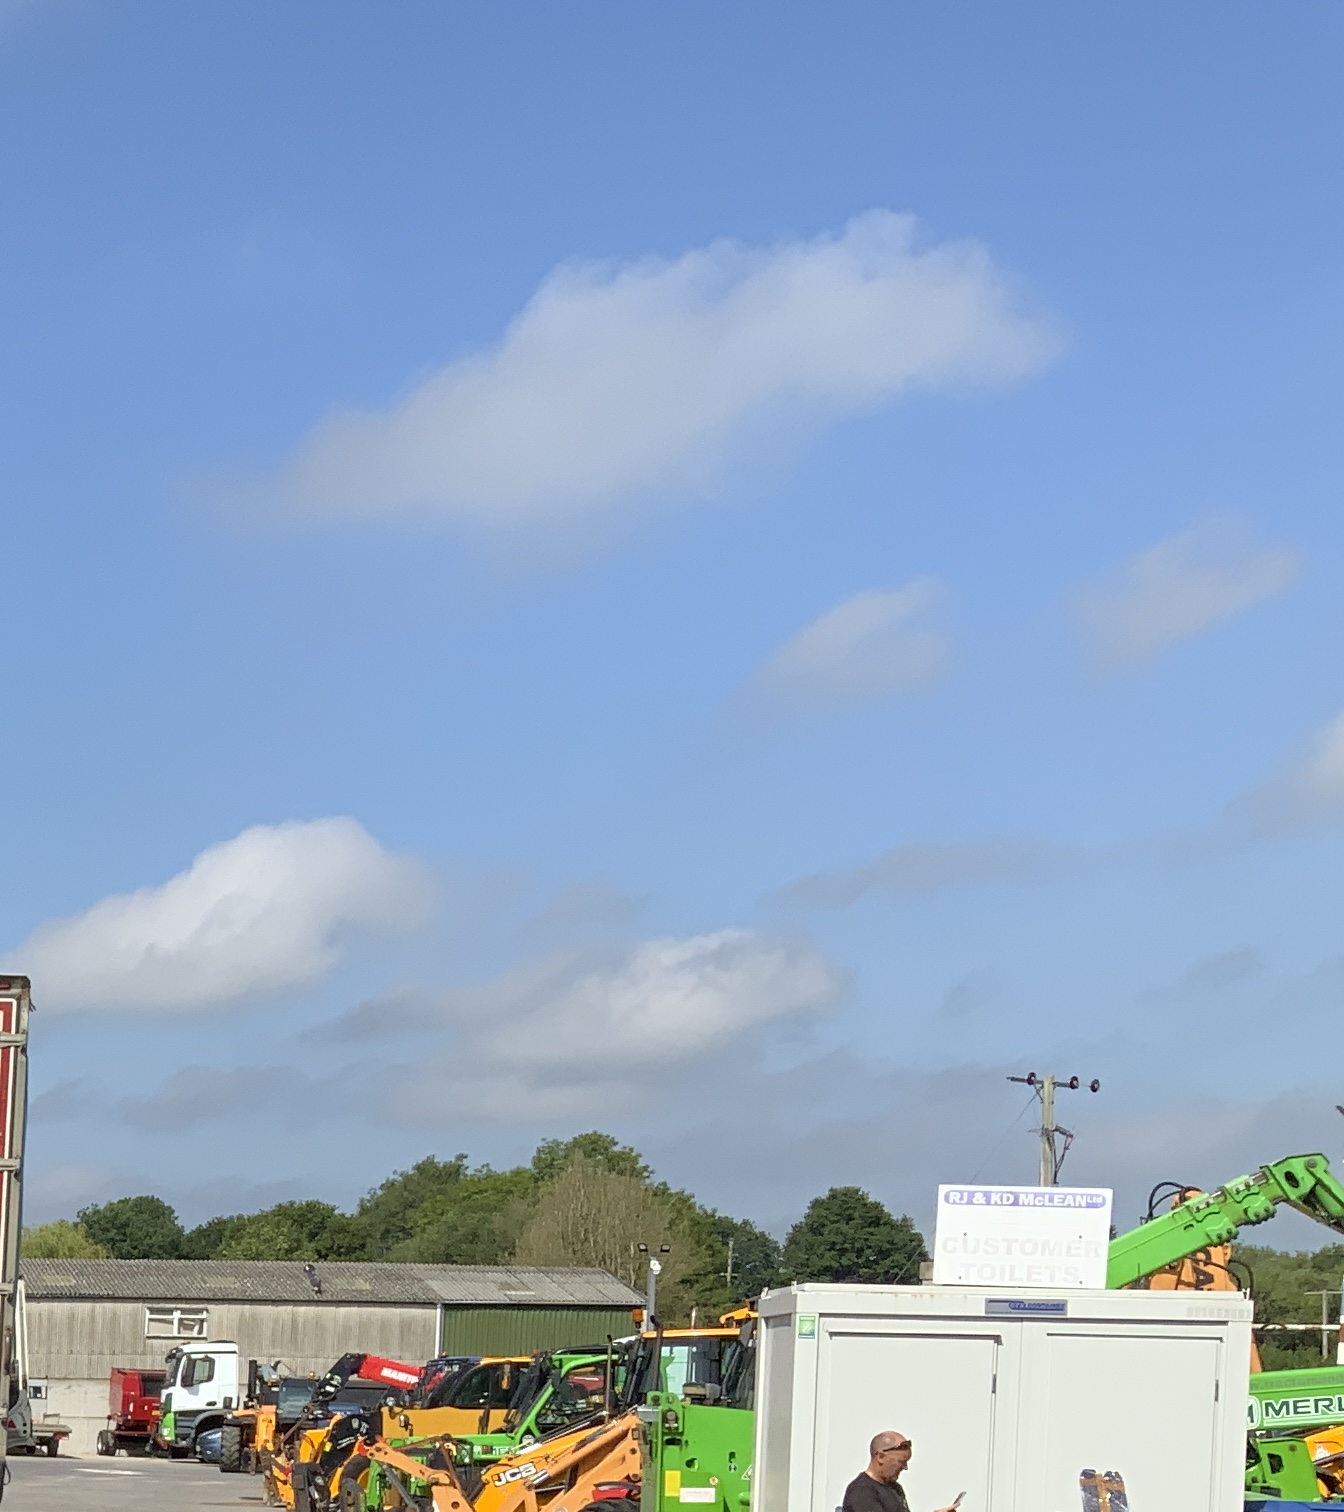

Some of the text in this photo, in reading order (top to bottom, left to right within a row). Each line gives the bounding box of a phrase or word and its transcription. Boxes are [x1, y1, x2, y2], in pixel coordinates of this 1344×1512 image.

[949, 1192, 968, 1204] RJ
[972, 1192, 986, 1205] &
[990, 1193, 1014, 1205] KD
[1018, 1193, 1087, 1207] McLEAN
[941, 1236, 1102, 1259] CUSTOMER
[959, 1262, 1082, 1284] TOILETS
[1264, 1396, 1344, 1417] MERL
[493, 1461, 537, 1487] JCB
